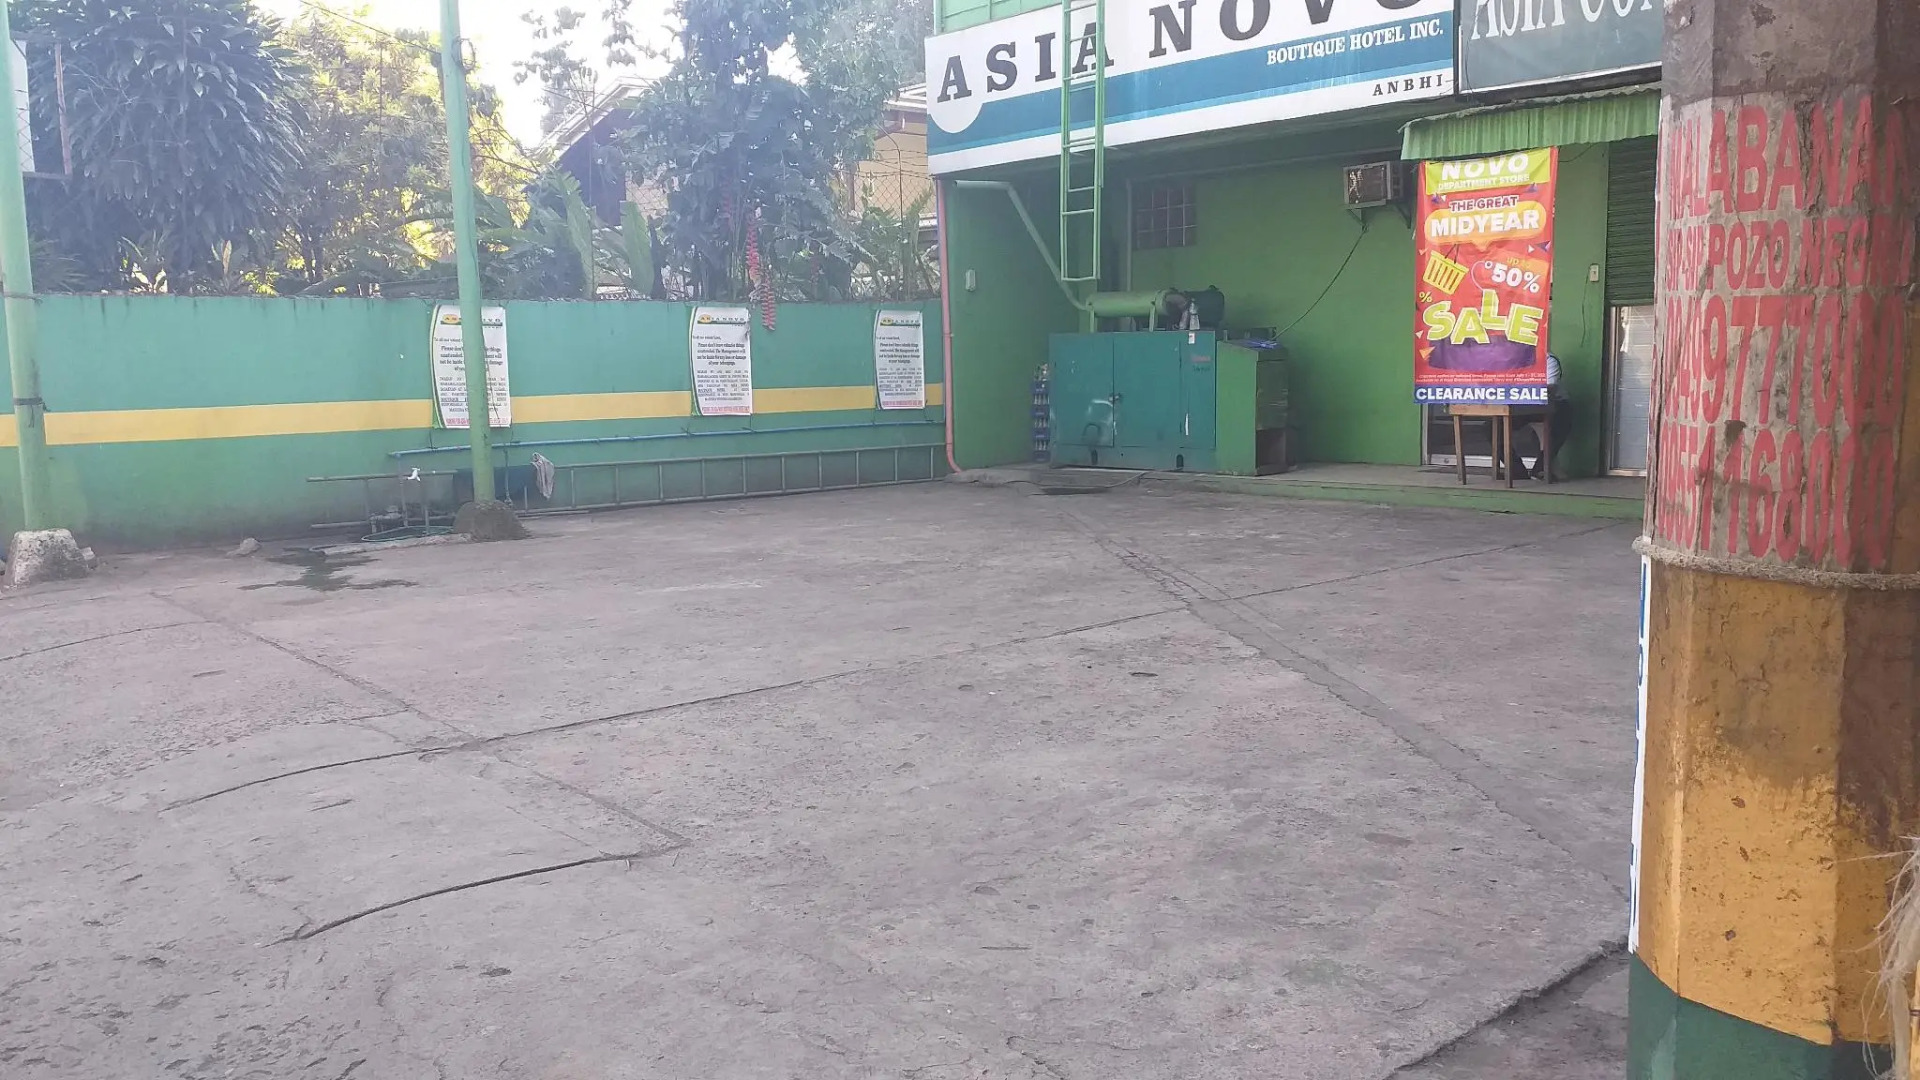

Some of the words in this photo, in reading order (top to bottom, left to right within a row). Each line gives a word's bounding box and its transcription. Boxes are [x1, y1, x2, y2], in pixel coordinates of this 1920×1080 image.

[937, 21, 1115, 103] ASIA
[1148, 0, 1423, 58] NO
[1266, 37, 1346, 66] BOUTIQUE
[1350, 25, 1405, 51] HOTEL
[1409, 18, 1444, 40] INC.
[1372, 73, 1444, 97] ANBHI
[1441, 152, 1529, 181] NOVO
[1438, 178, 1498, 191] DEPARTMENT
[1499, 173, 1530, 184] STORE
[1450, 199, 1474, 213] THE
[1477, 196, 1518, 210] GREAT
[1431, 209, 1540, 237] MIDYEAR
[1706, 219, 1790, 291] POZO
[1491, 262, 1541, 294] 50%
[1422, 288, 1545, 347] SALE
[1415, 387, 1505, 400] CLEARANCE
[1509, 387, 1548, 400] SALE
